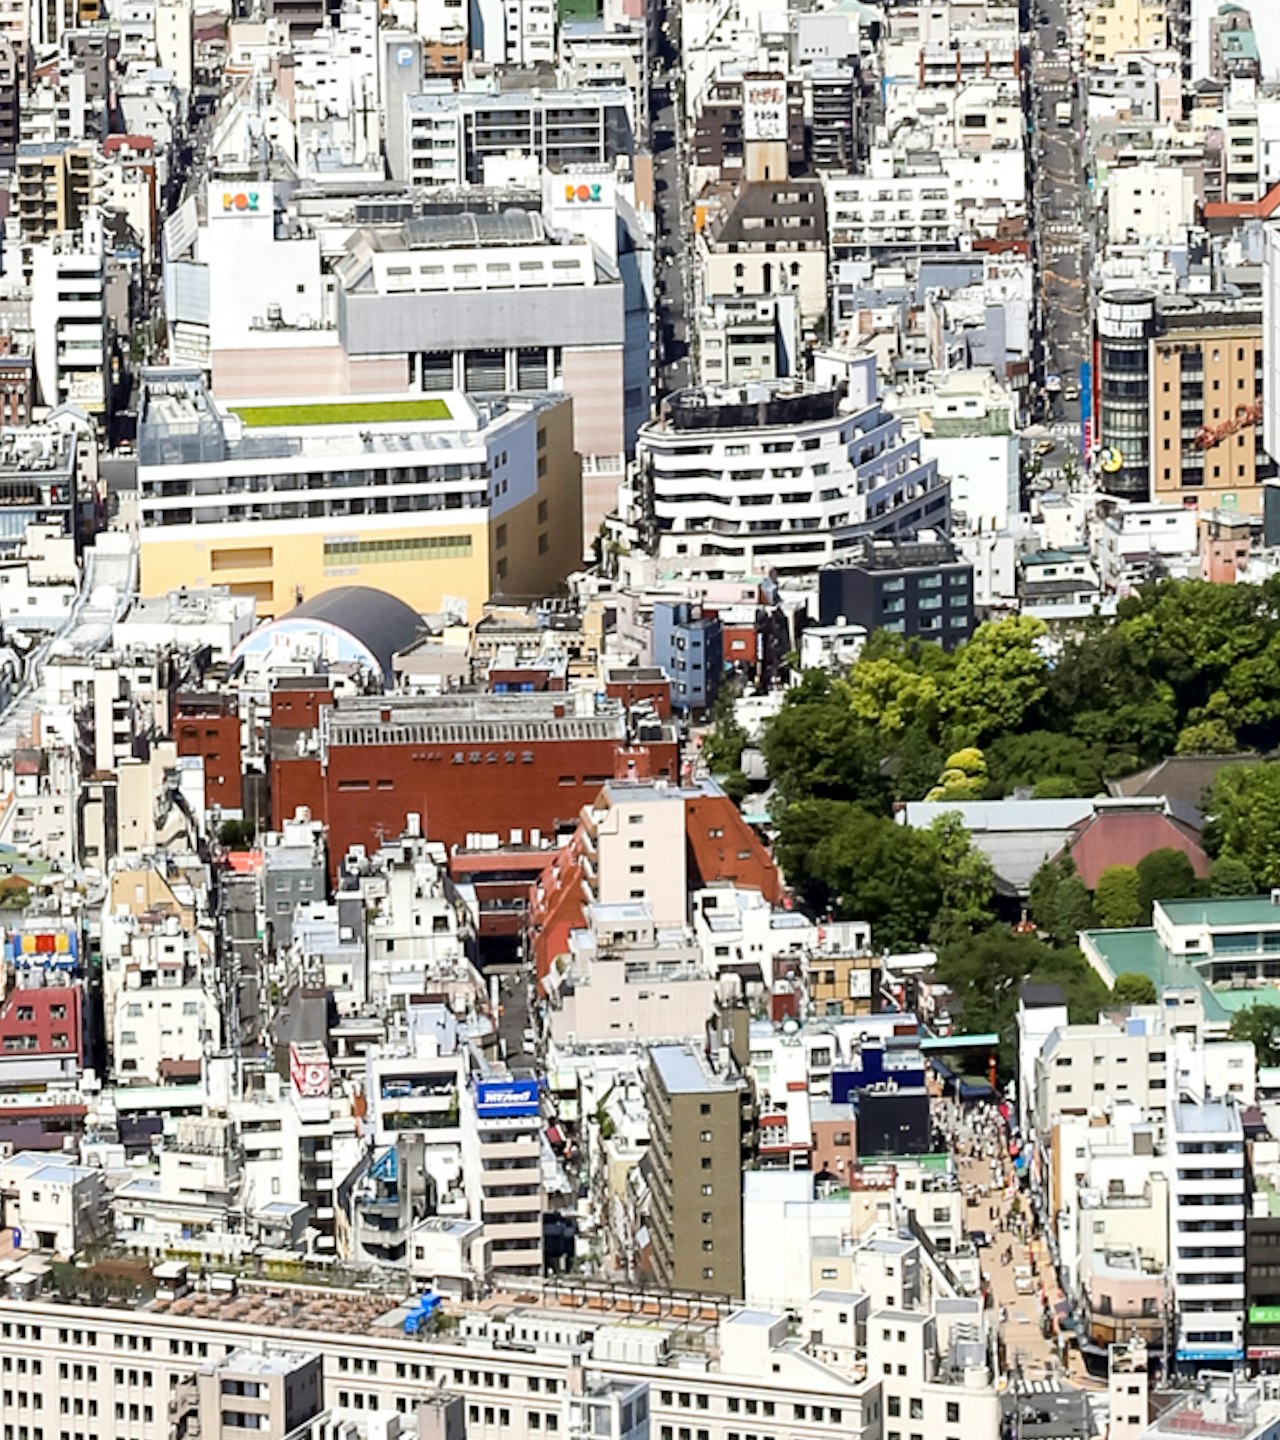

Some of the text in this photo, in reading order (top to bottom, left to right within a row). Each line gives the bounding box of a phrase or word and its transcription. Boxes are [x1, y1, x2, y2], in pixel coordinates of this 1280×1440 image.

[398, 48, 412, 65] P
[223, 192, 259, 211] ROX
[565, 183, 602, 203] ROX
